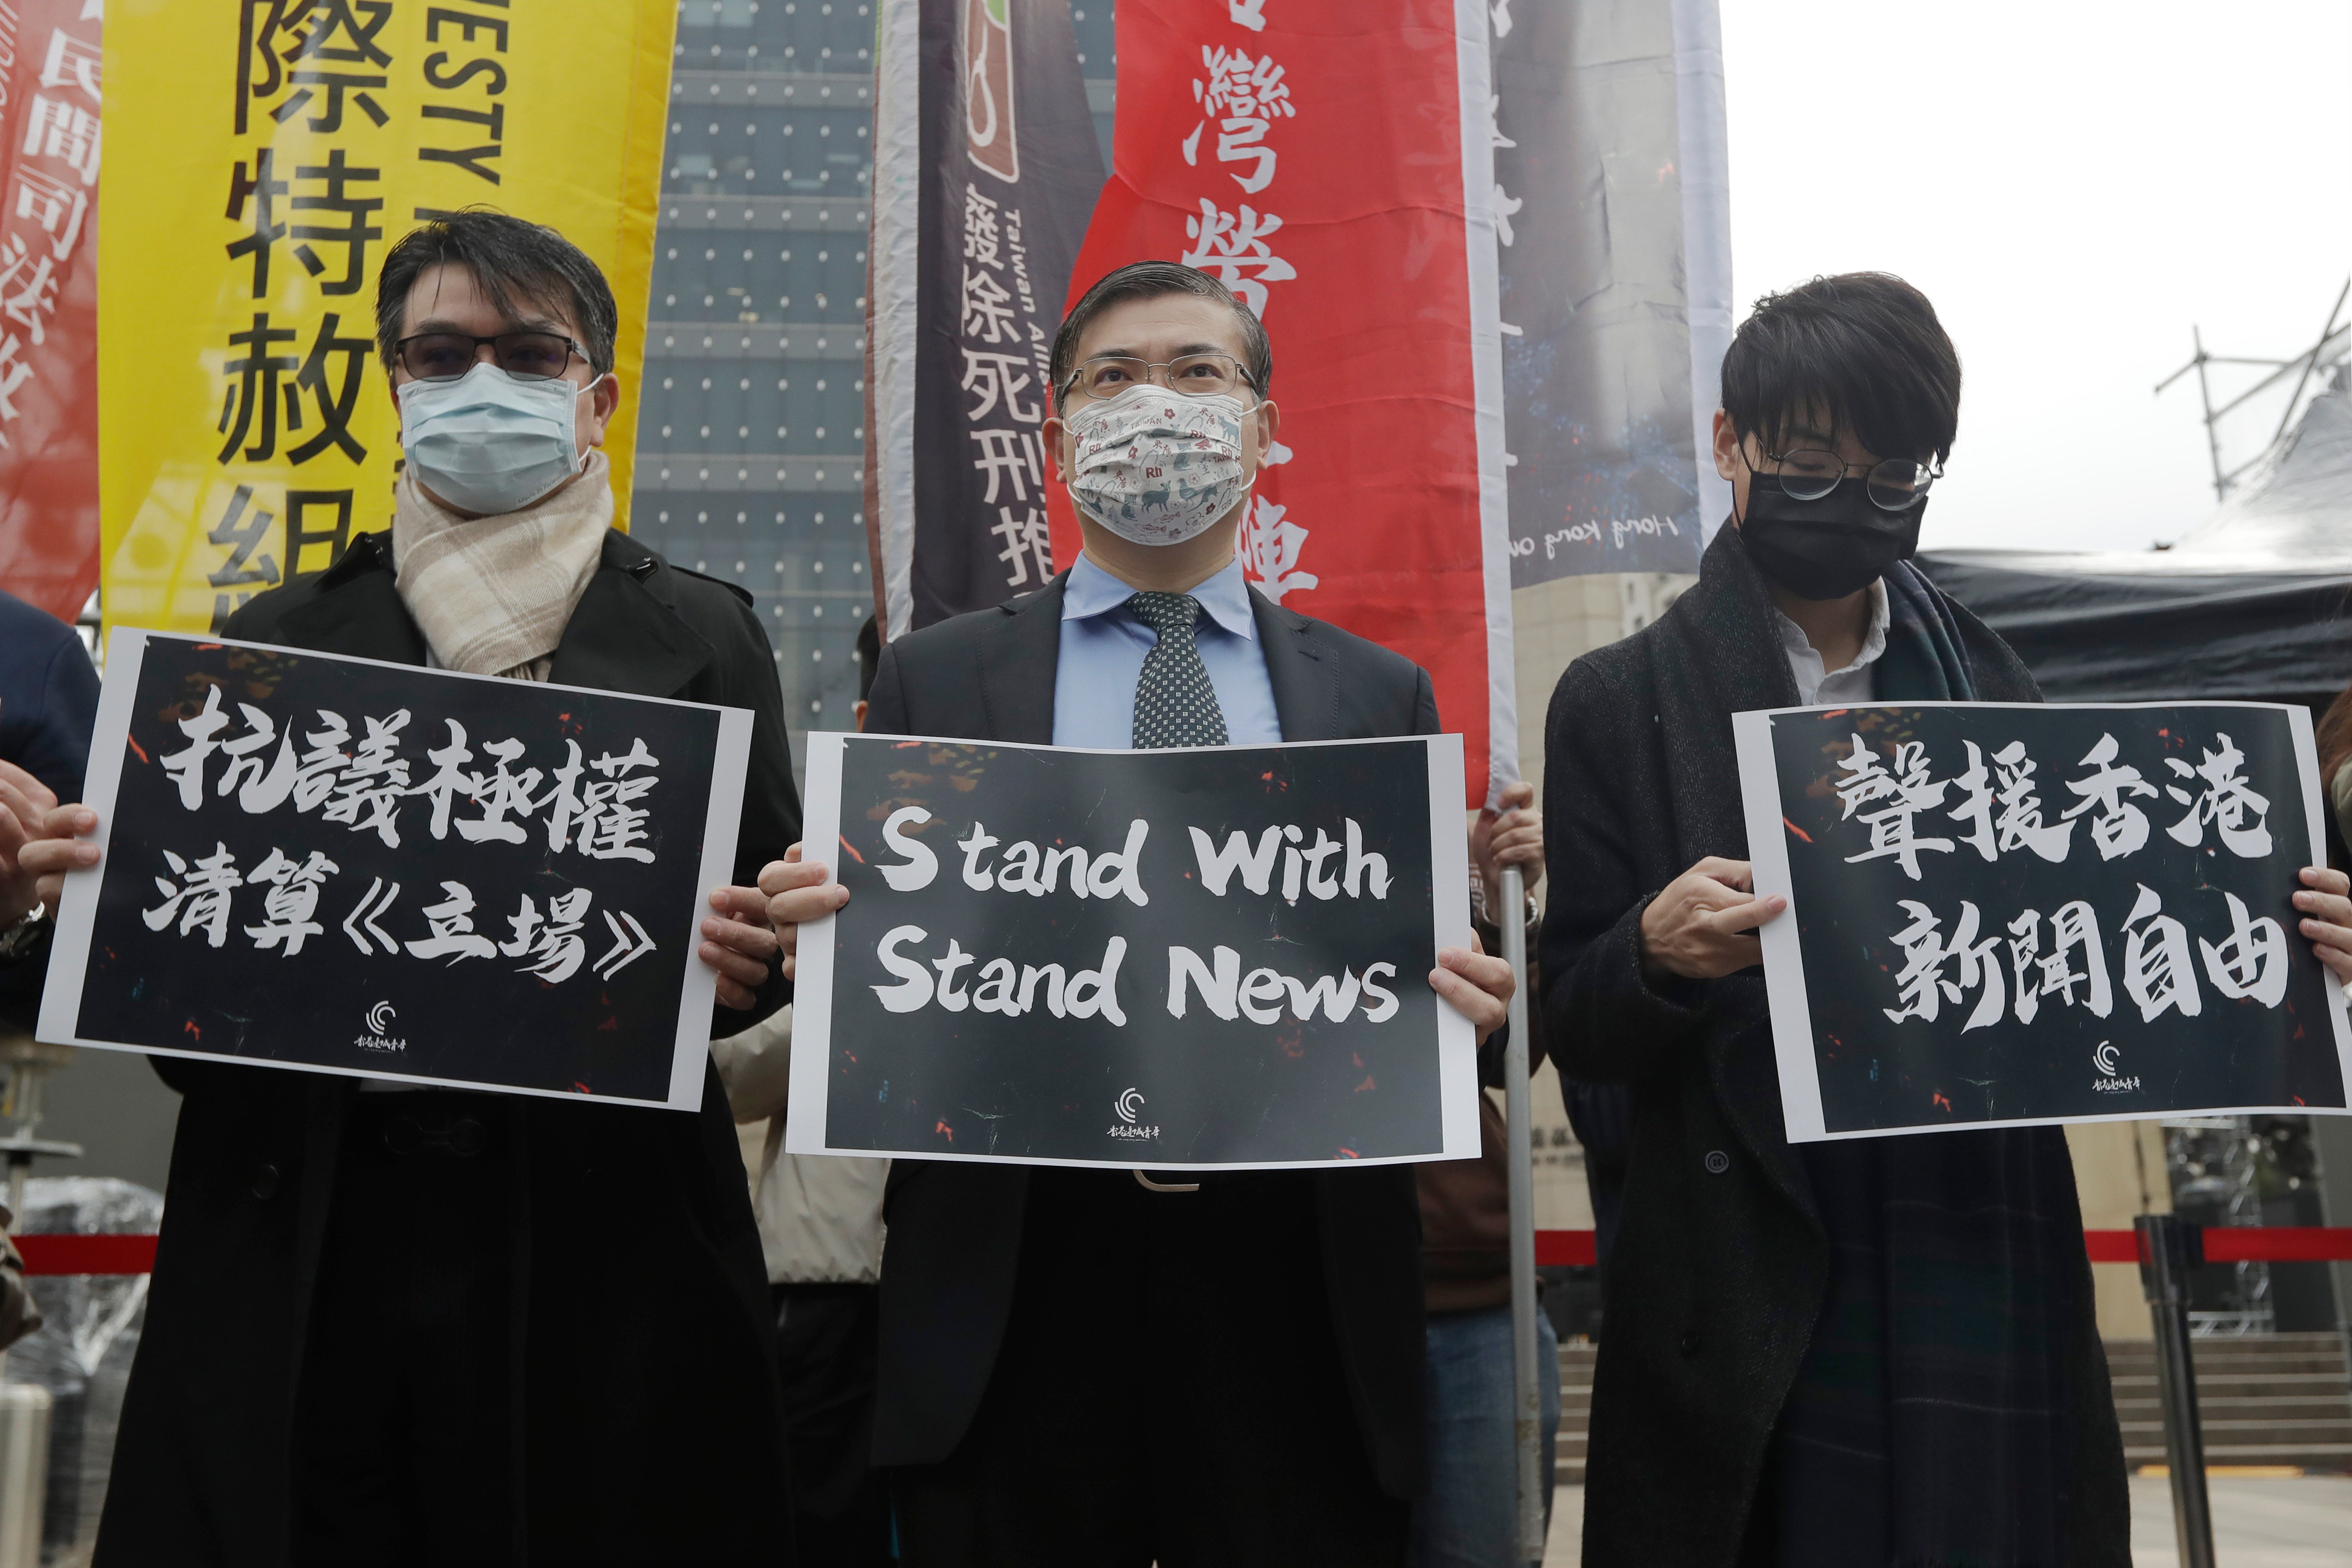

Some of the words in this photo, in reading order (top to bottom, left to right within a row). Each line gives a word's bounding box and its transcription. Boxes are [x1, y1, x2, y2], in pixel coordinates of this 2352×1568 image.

[419, 0, 510, 186] ESTY
[0, 27, 103, 449] 民間司法
[1005, 208, 1037, 314] Taiwan
[1026, 321, 1051, 394] Allia
[1182, 0, 1319, 606] 灣勞陣
[960, 183, 1055, 599] 廢除死刑推
[1131, 418, 1162, 430] TAIWAN
[160, 683, 660, 864] 抗議極權
[875, 806, 1149, 907] Stand
[1188, 817, 1394, 907] With
[1835, 732, 2272, 881] 聲援香港
[869, 925, 1127, 1027] Stand
[1167, 946, 1399, 1025] News
[1883, 883, 2288, 1034] 新聞自由
